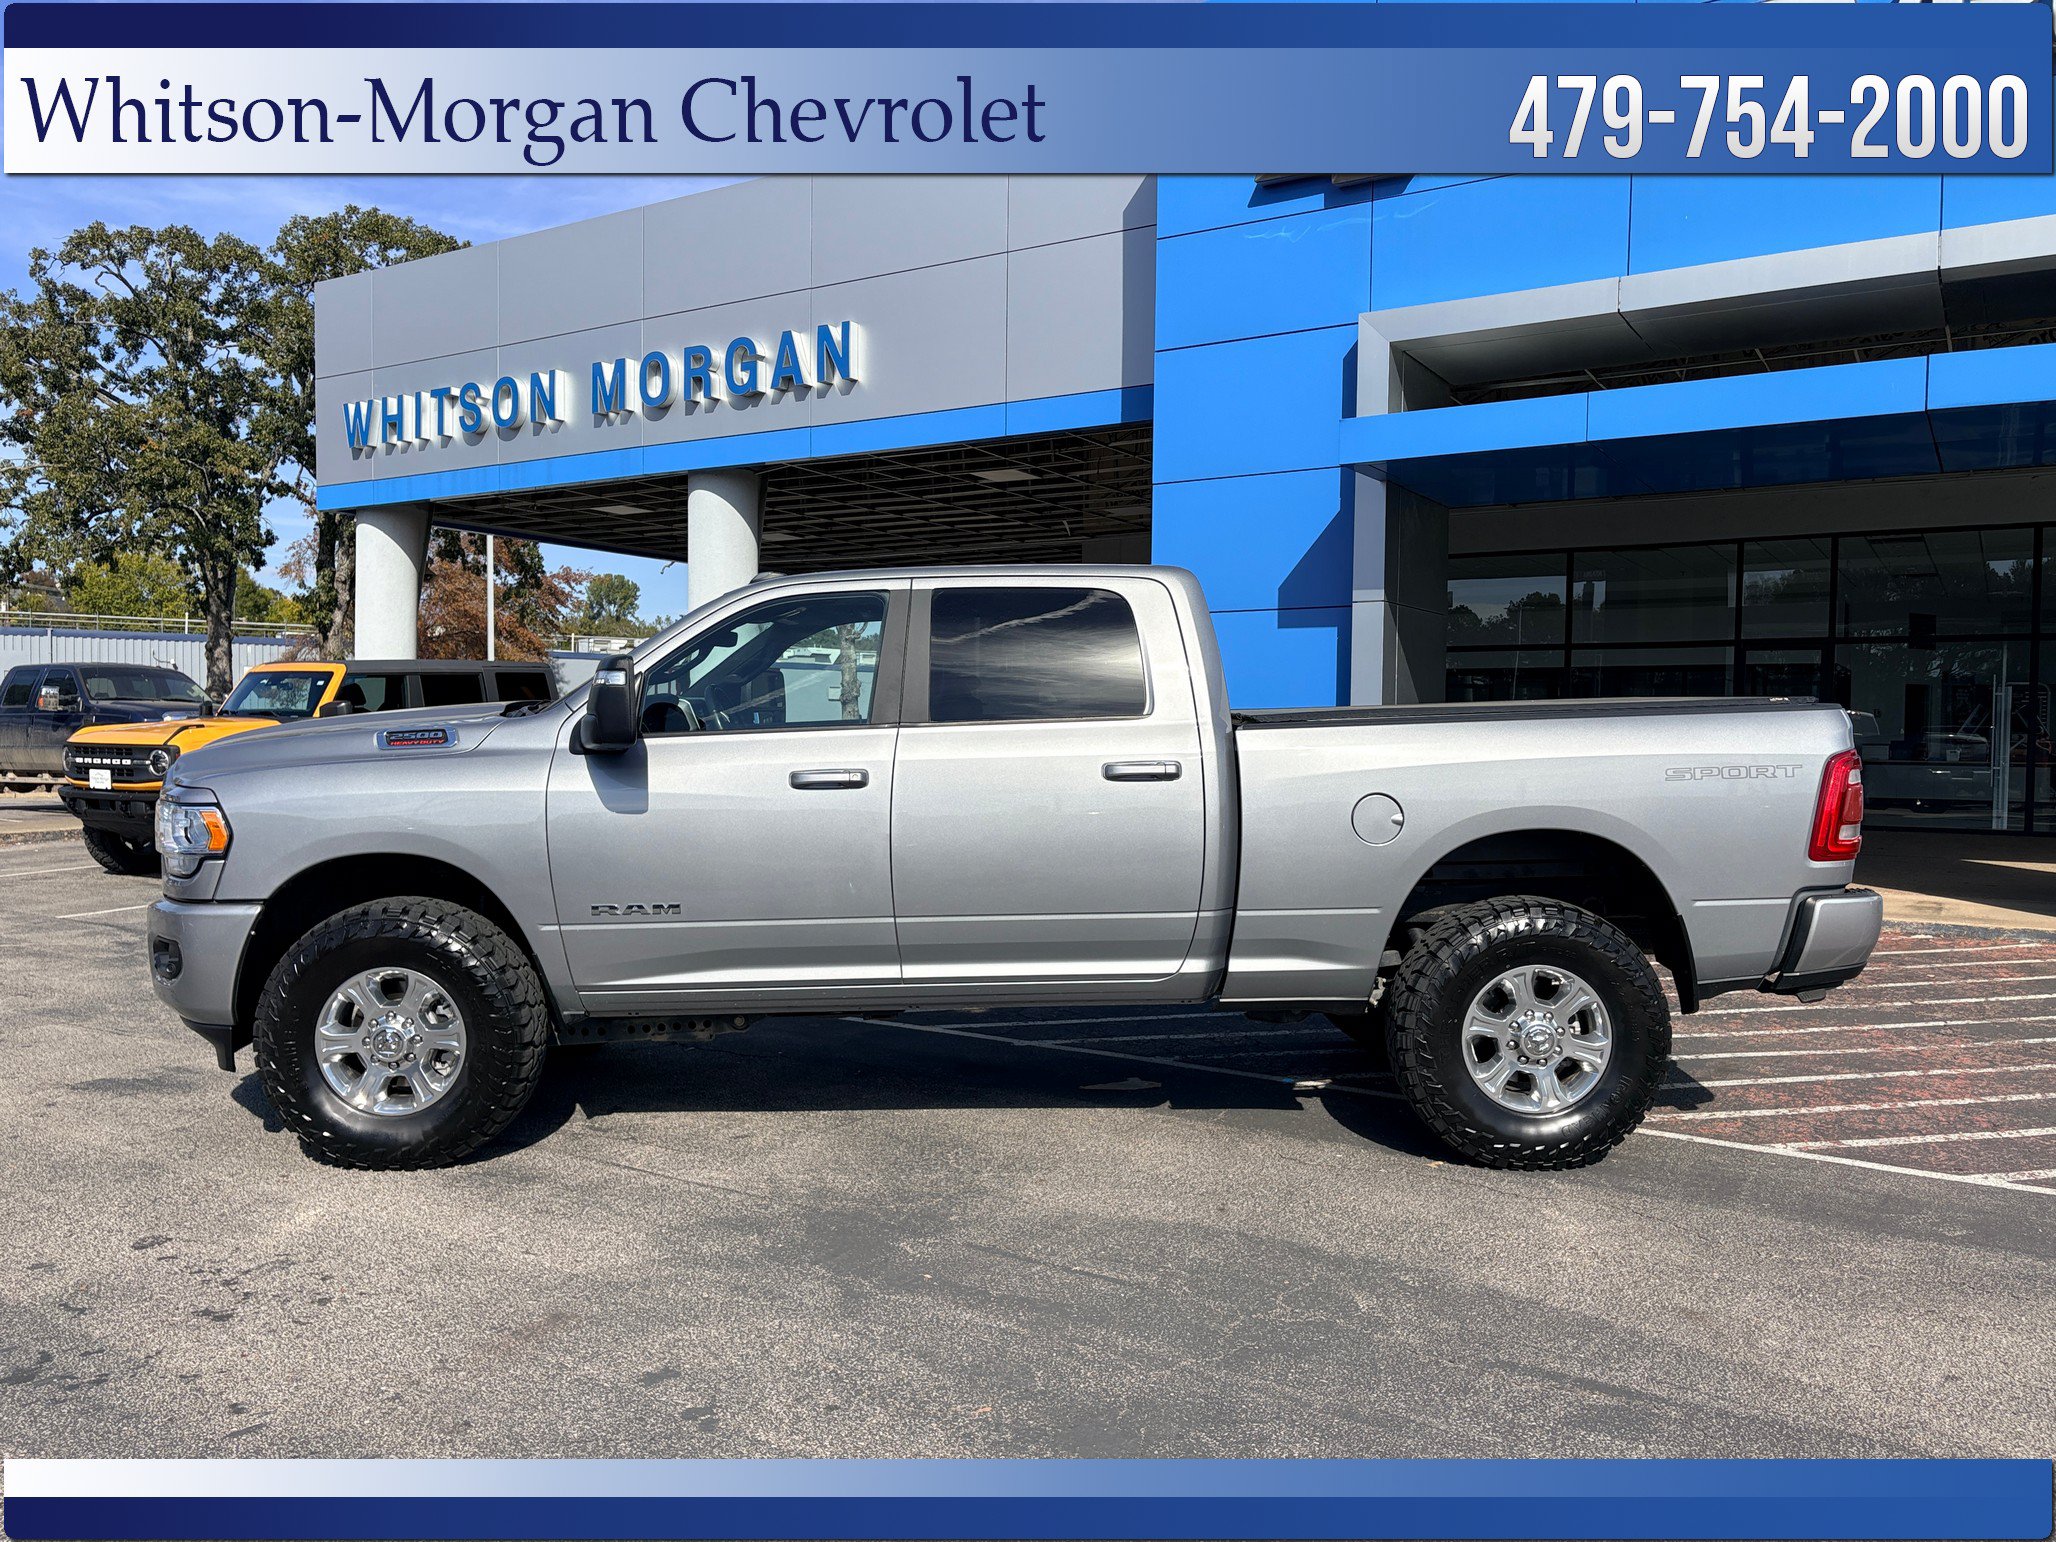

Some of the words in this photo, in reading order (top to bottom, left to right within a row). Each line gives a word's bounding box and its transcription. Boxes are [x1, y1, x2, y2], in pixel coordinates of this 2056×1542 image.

[343, 369, 565, 449] WHITSON
[592, 320, 860, 415] MORGAN
[389, 731, 443, 740] 2500
[75, 757, 131, 765] BRONCO
[1665, 764, 1803, 781] SPORT
[591, 902, 681, 916] RAM
